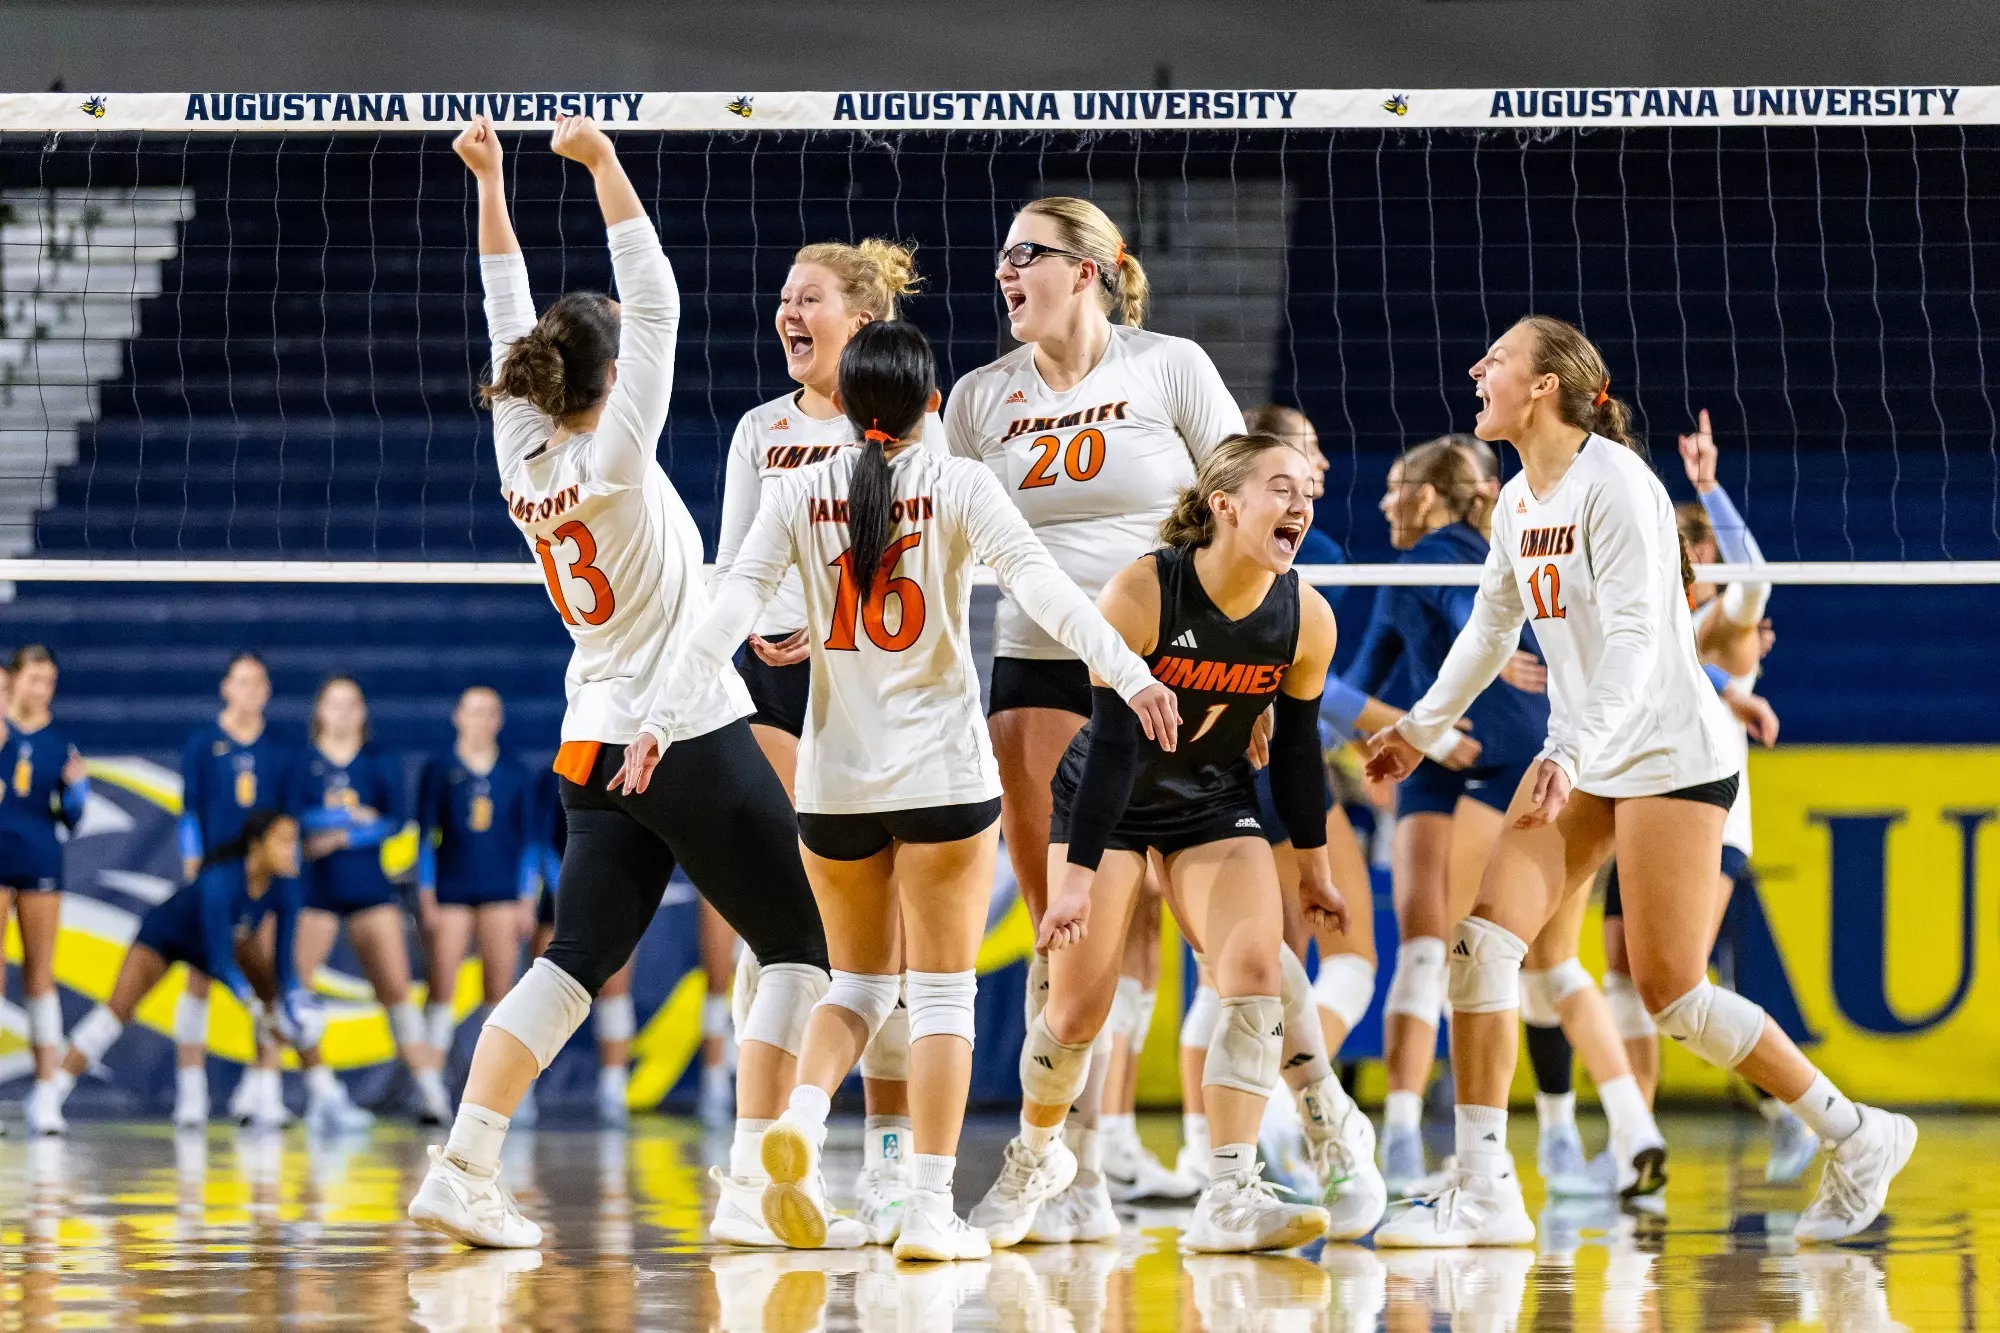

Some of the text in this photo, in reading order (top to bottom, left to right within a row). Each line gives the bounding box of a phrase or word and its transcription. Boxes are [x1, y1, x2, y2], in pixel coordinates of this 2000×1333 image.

[185, 93, 643, 122] AUGUSTANA UNIVERSITY
[833, 91, 1298, 121] AUGUSTANA UNIVERSITY
[1489, 88, 1960, 118] AUGUSTANA UNIVERSITY
[1018, 428, 1106, 490] 20
[809, 496, 934, 526] JAMOWN
[535, 520, 616, 626] 13
[824, 531, 926, 653] 16
[1527, 563, 1567, 620] 12
[1151, 656, 1290, 694] JIMMIES
[1188, 703, 1231, 743] 1
